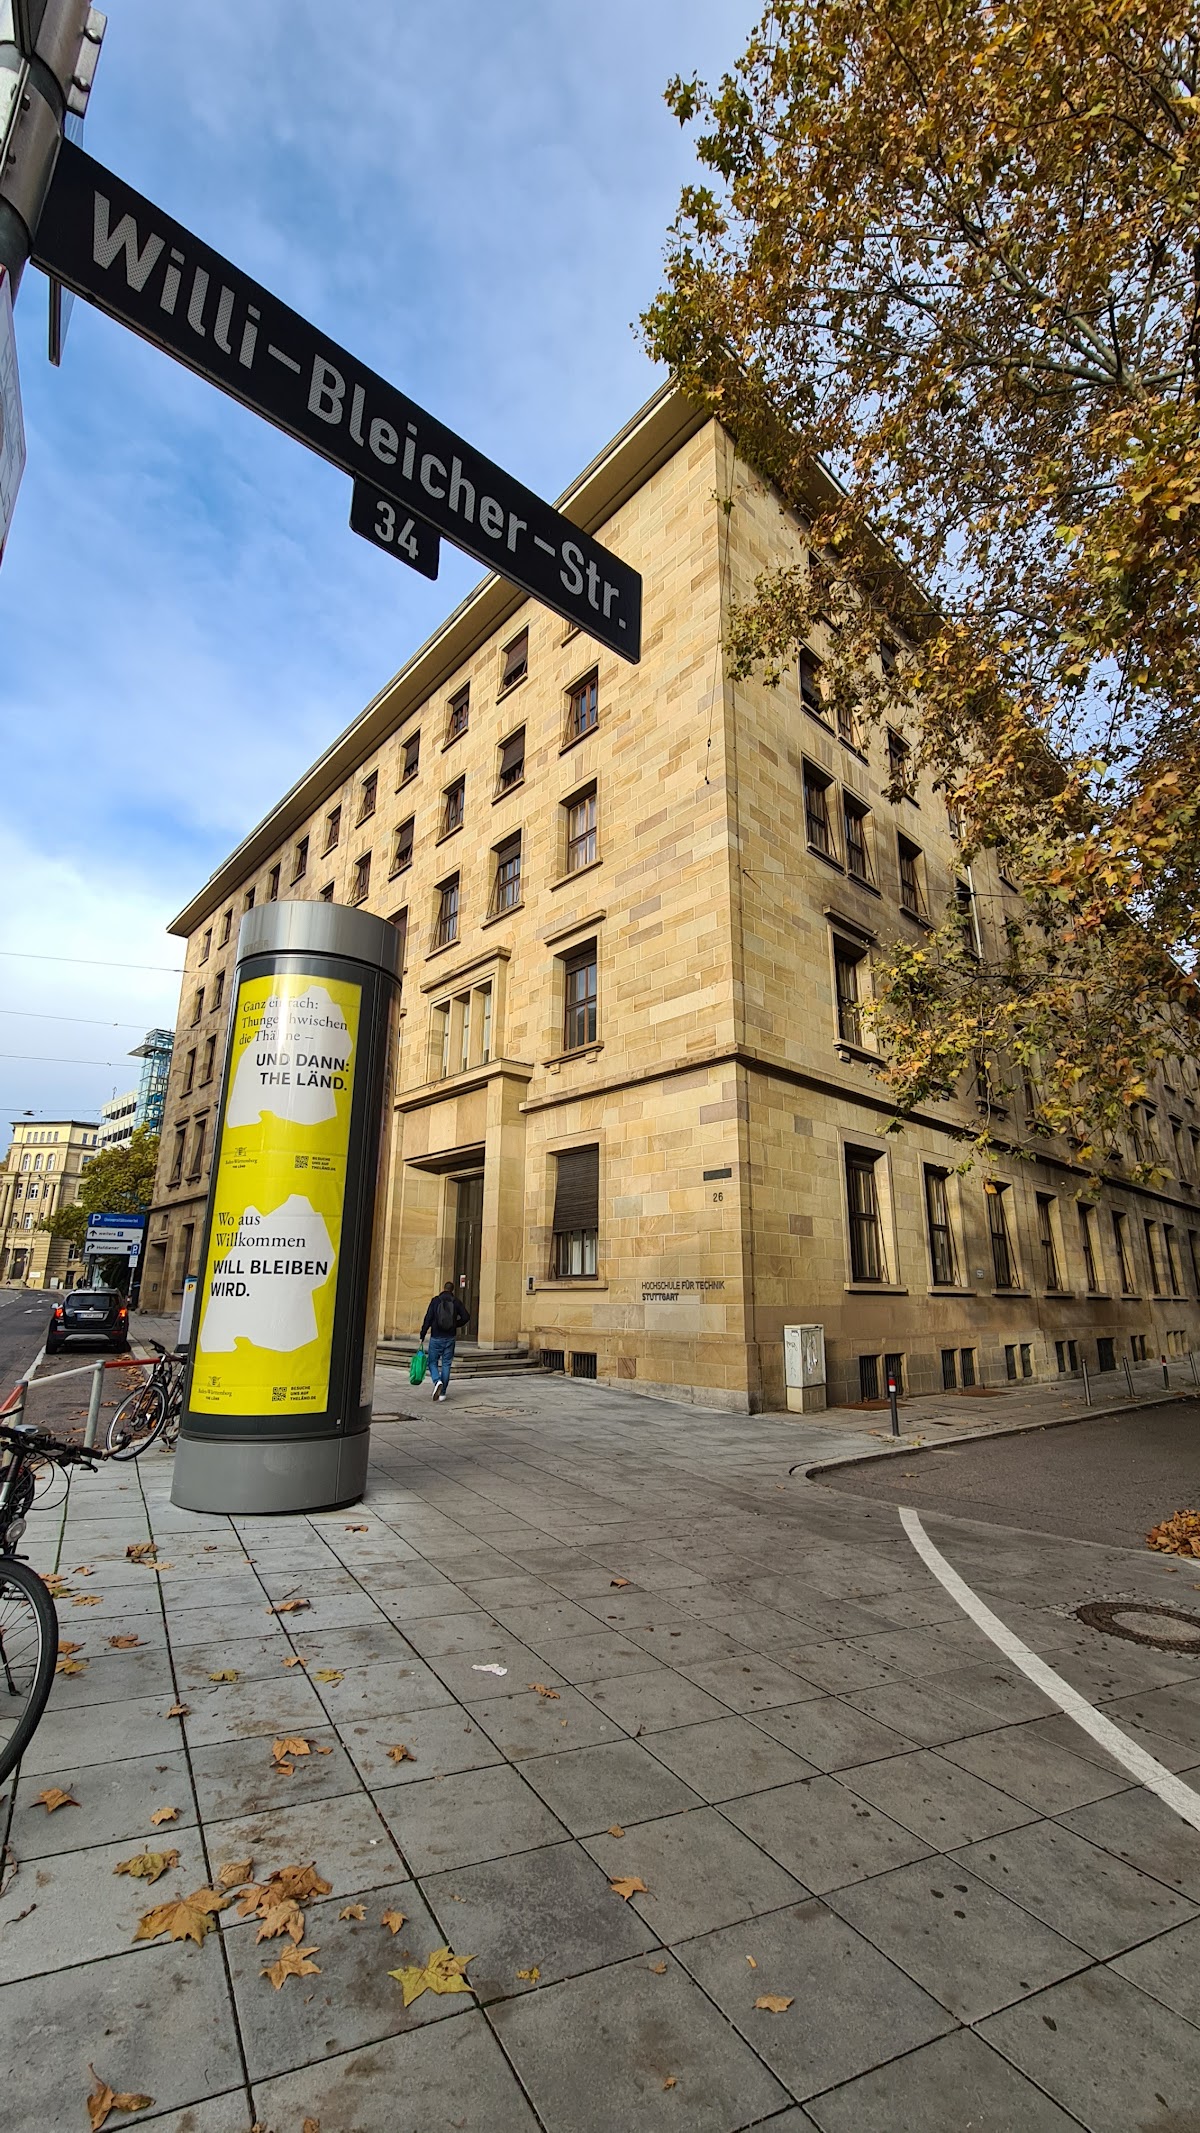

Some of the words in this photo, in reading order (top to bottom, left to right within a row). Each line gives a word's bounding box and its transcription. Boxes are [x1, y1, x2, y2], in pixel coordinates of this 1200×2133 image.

[91, 190, 627, 628] Willi-Bleicher-Str.
[375, 500, 419, 559] 34
[243, 1000, 266, 1013] Ganz
[239, 1033, 252, 1046] die
[256, 1053, 290, 1067] UND
[295, 1053, 350, 1073] DANN:
[260, 1072, 291, 1085] THE
[296, 1070, 348, 1091] LÄND.
[712, 1192, 724, 1203] 26
[218, 1212, 235, 1226] Wo
[238, 1215, 261, 1226] aus
[216, 1232, 306, 1248] Willkommen
[213, 1259, 245, 1274] WILL
[250, 1260, 328, 1275] BLEIBEN
[210, 1282, 250, 1297] WIRD.
[641, 1281, 680, 1290] HOCHSCHULE
[681, 1279, 695, 1290] FÜR
[695, 1280, 725, 1290] TECHNIK
[641, 1292, 679, 1301] STUTTGART
